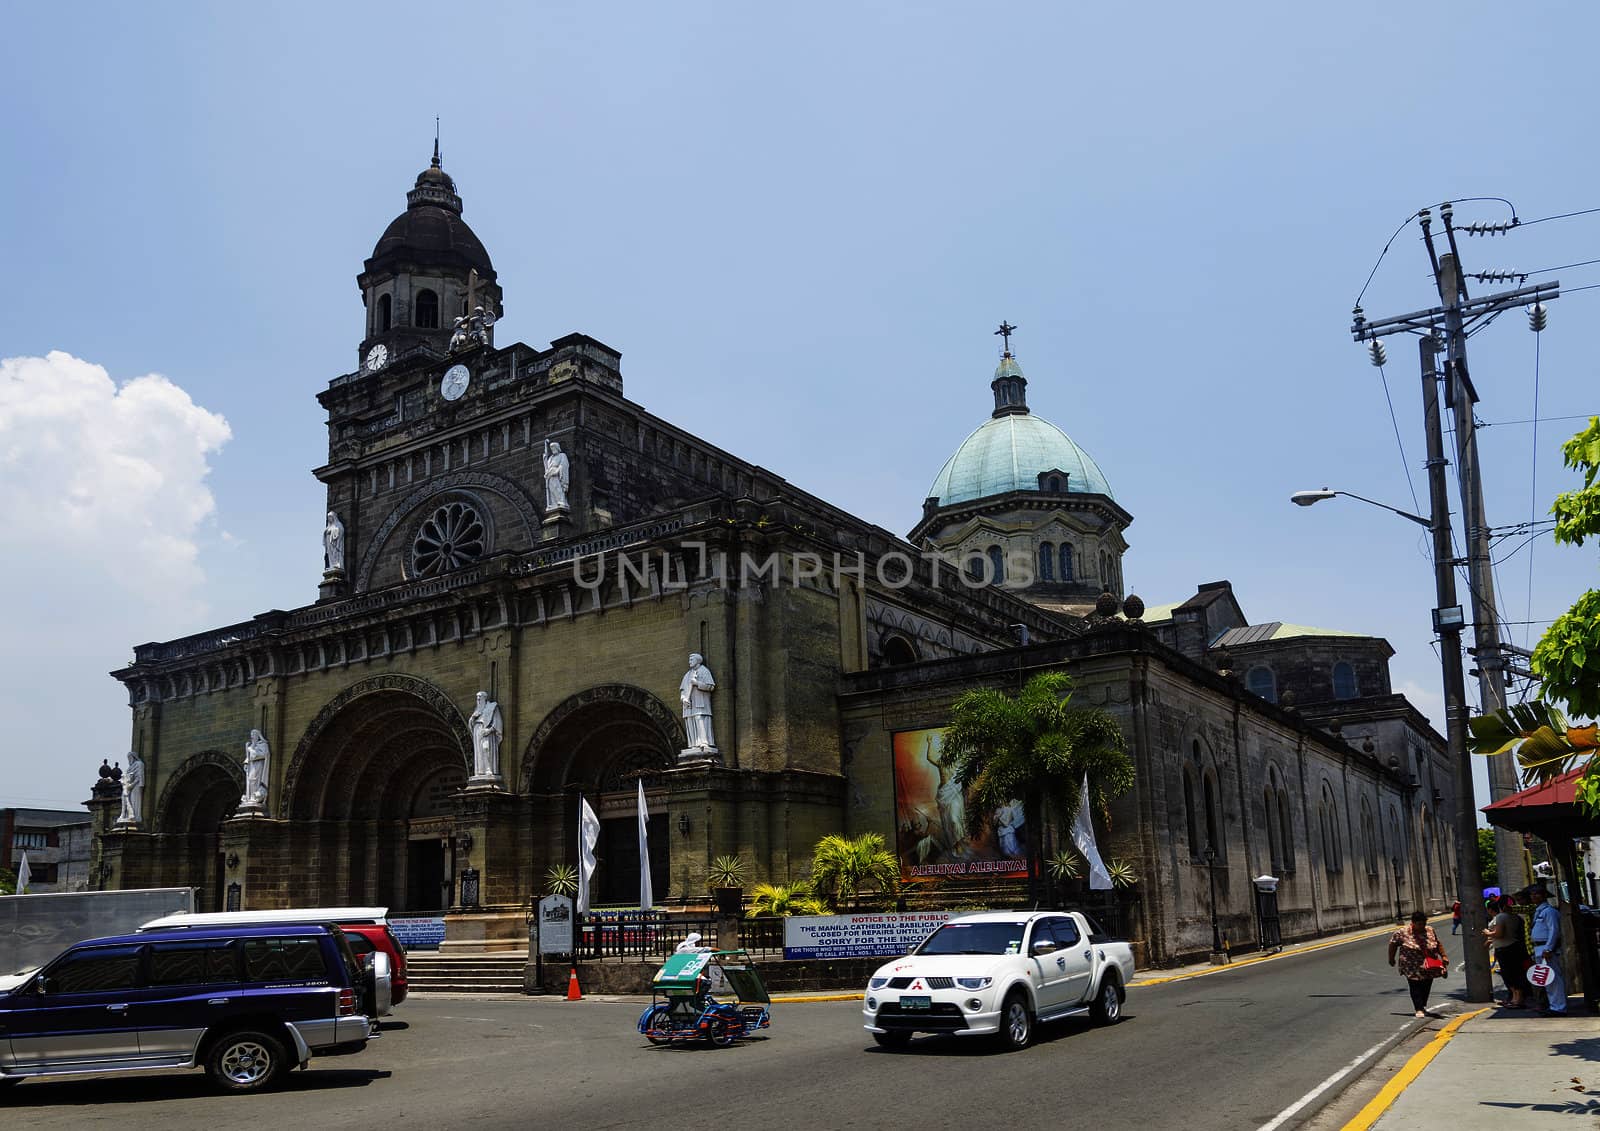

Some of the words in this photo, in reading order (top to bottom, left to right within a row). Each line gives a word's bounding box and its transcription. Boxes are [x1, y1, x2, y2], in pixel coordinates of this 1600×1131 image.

[911, 862, 967, 876] ALELUYA!
[969, 859, 1027, 873] ALELUYA!
[1532, 965, 1550, 985] STOP
